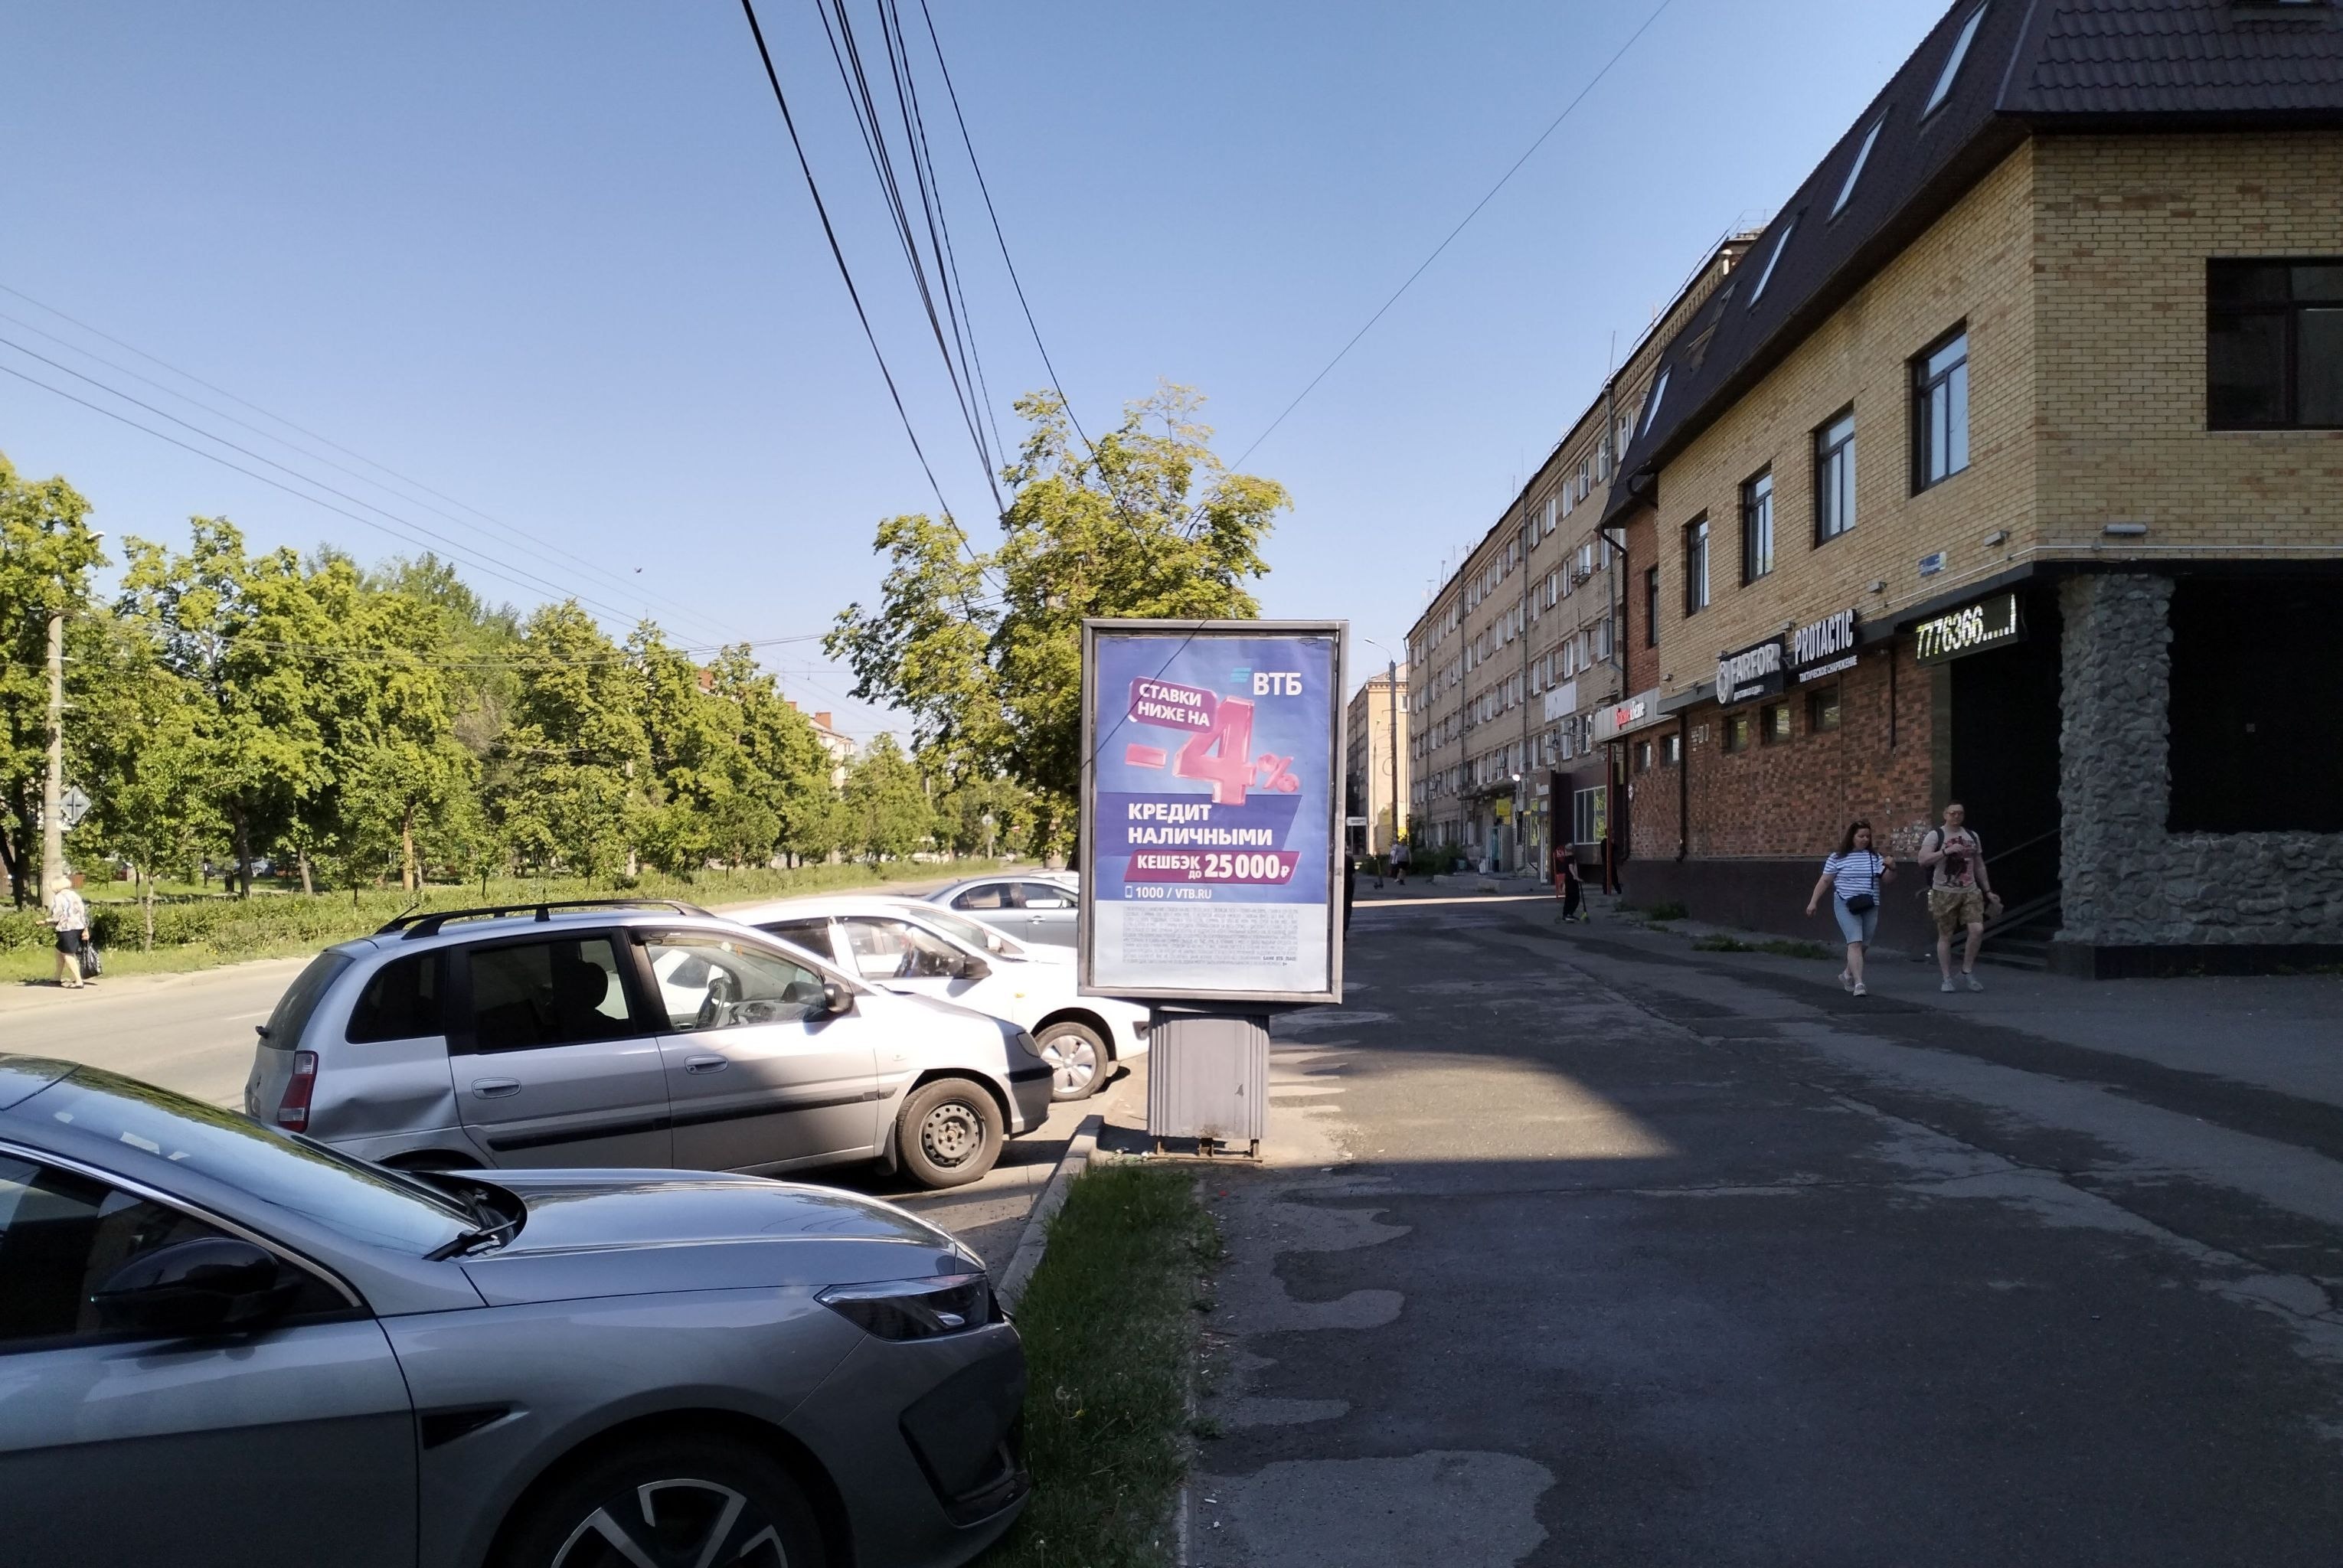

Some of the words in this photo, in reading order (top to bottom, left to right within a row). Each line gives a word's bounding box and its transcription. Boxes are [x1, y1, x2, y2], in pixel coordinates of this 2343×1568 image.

[1796, 609, 1853, 665] PROTACTIC
[1730, 644, 1780, 685] FARFOR
[1139, 683, 1201, 707] СТАВКИ
[1253, 672, 1302, 696] ВТБ
[1138, 701, 1185, 722] НИЖЕ
[1188, 712, 1210, 727] НА
[1129, 803, 1212, 824] КРЕДИТ
[1129, 828, 1273, 846] НАЛИЧНЫМИ
[1138, 855, 1201, 870] КЕШБЭК
[1136, 887, 1164, 899] 1000
[1175, 889, 1212, 900] VTB.RU
